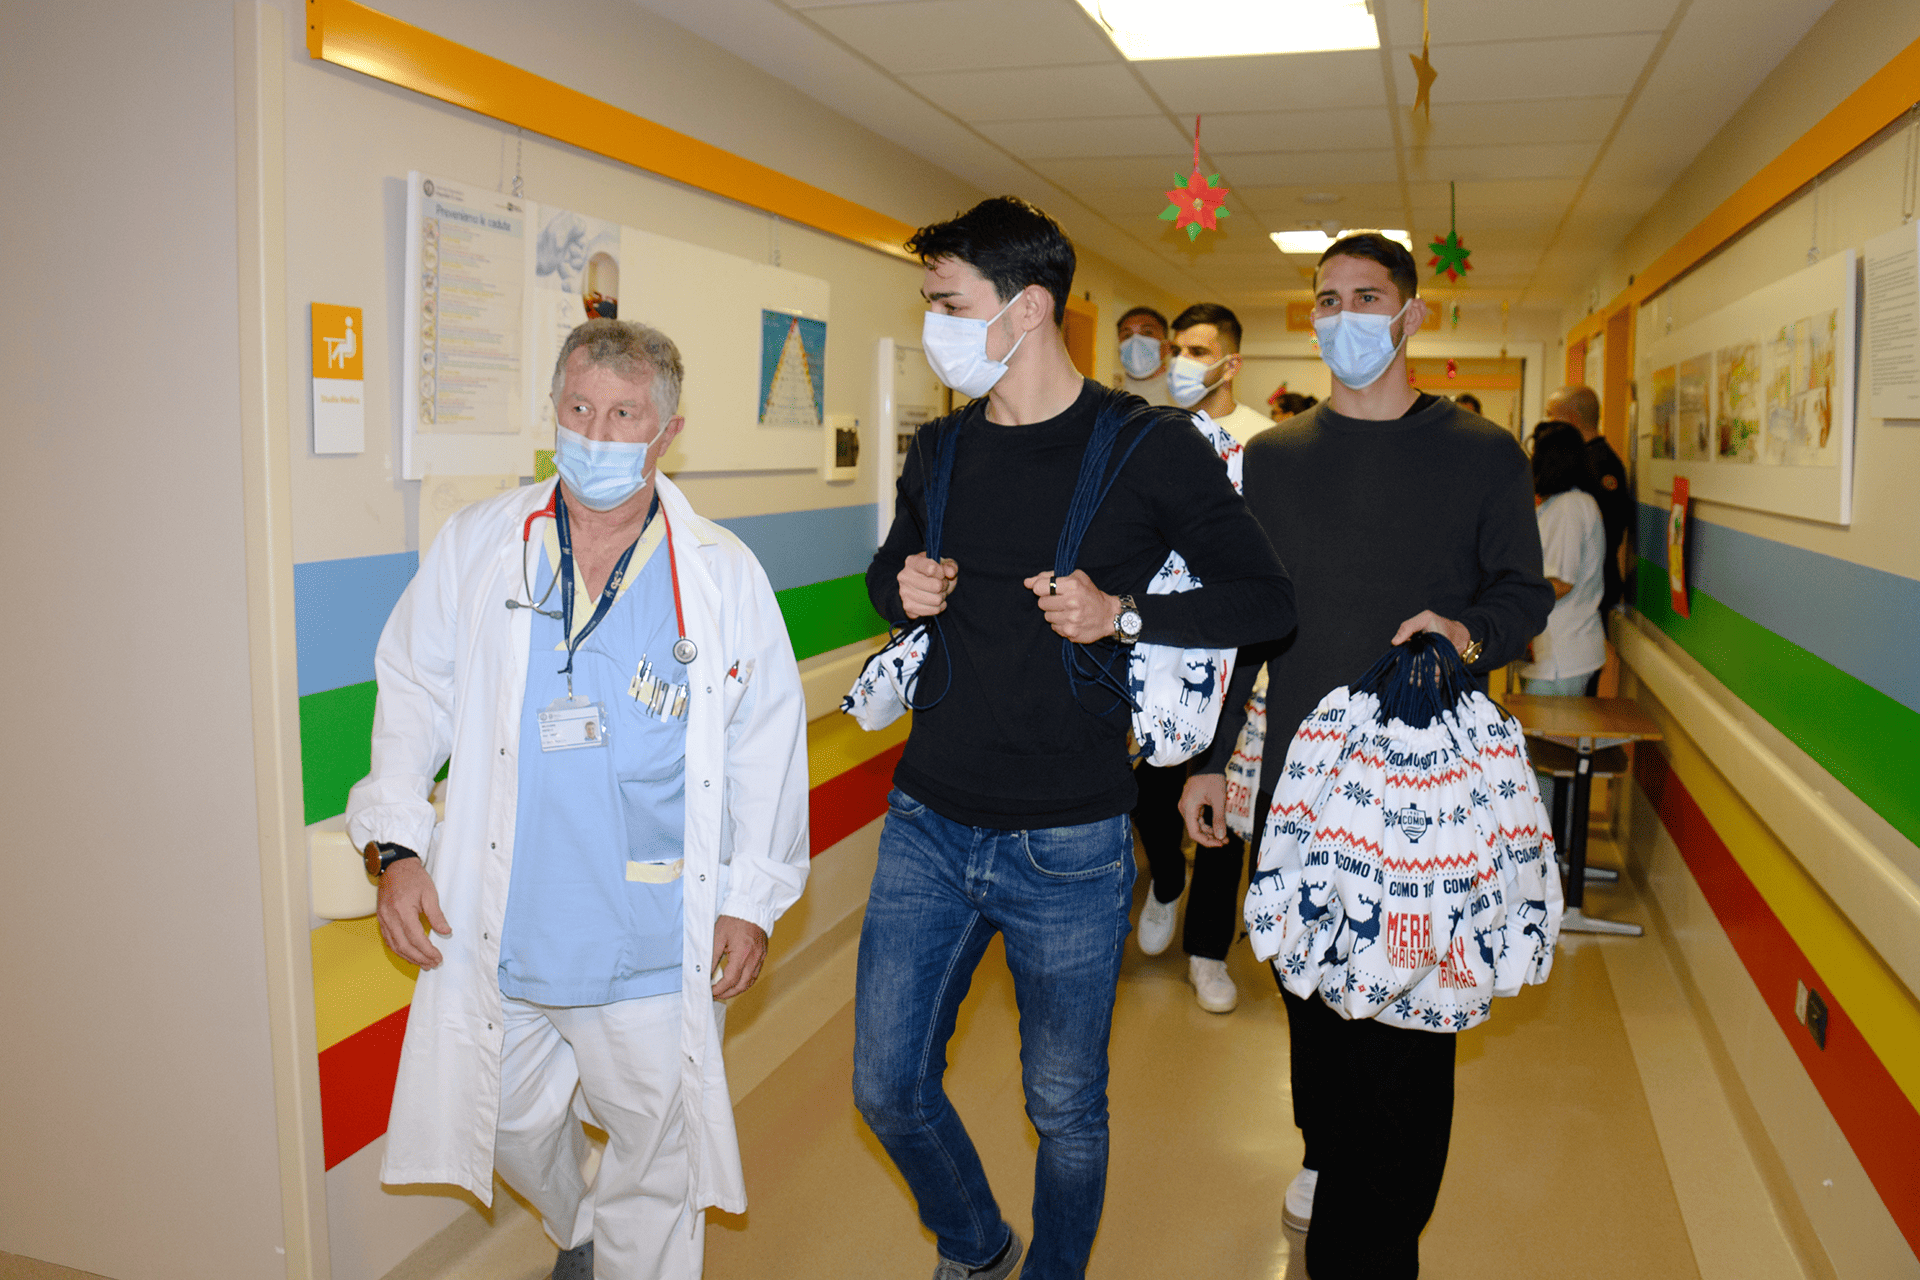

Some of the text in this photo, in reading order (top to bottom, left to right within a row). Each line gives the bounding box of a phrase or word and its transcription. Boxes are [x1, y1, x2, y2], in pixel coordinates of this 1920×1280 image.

[1402, 815, 1425, 826] COMO
[1338, 854, 1371, 878] COMO
[1389, 881, 1419, 898] COMO
[1387, 911, 1432, 949] MERR
